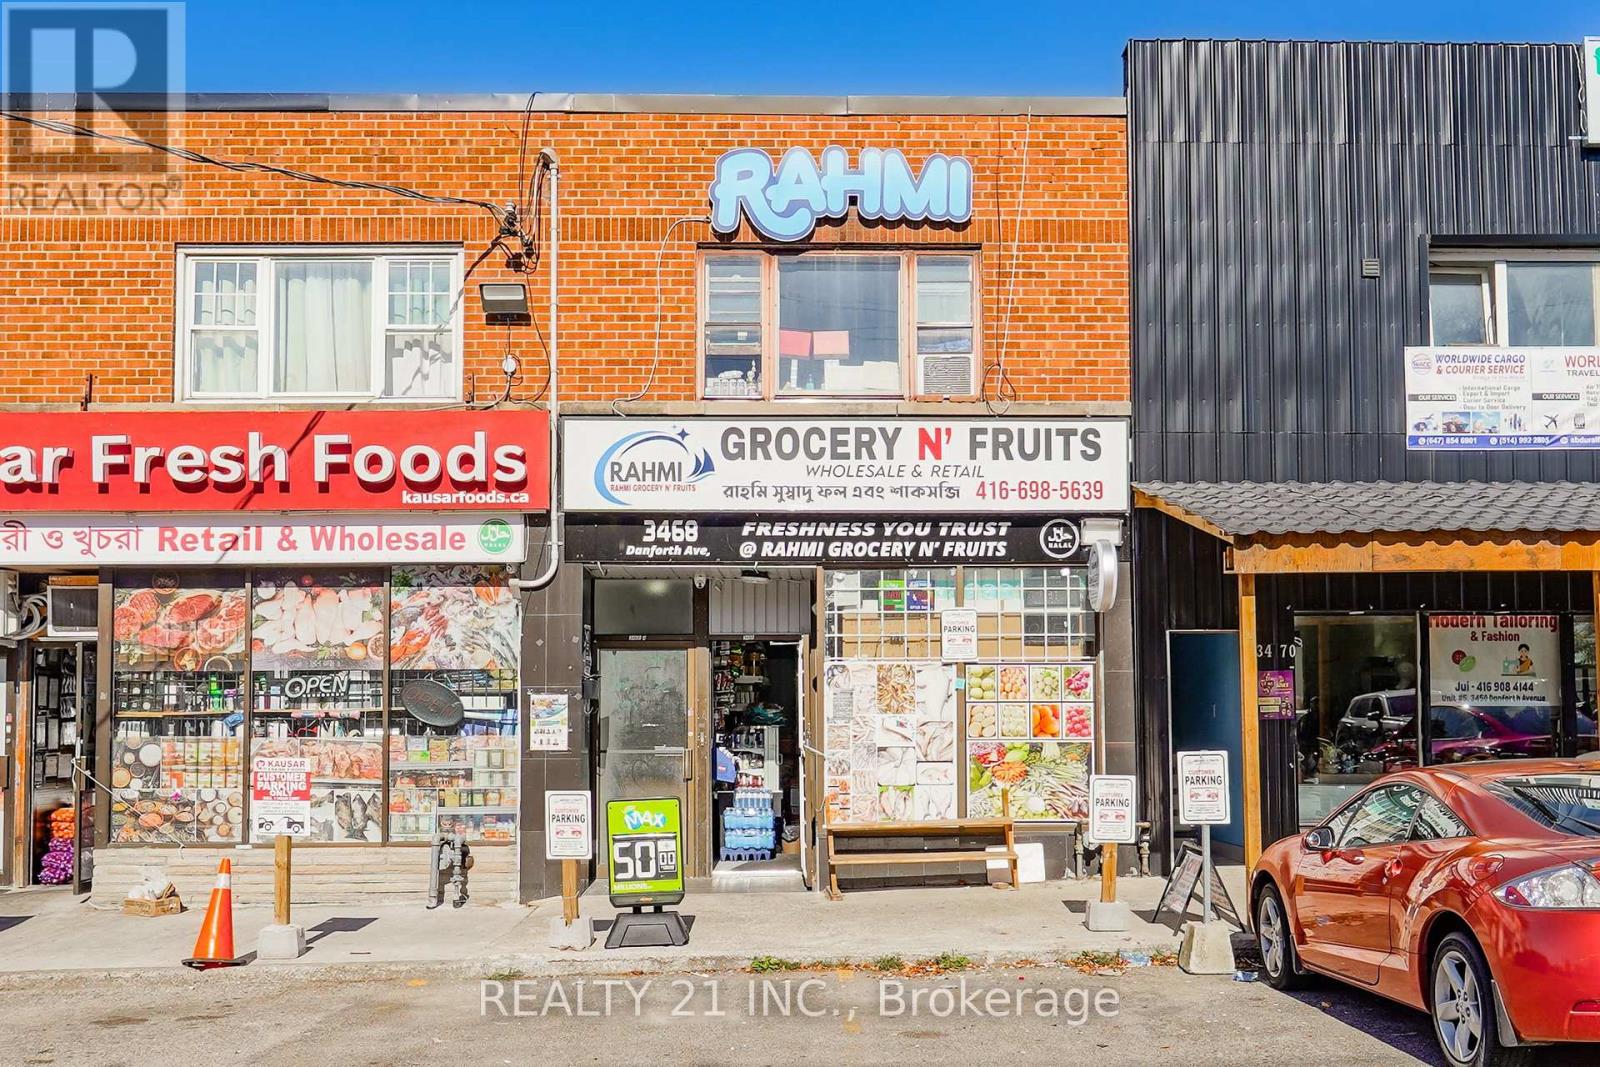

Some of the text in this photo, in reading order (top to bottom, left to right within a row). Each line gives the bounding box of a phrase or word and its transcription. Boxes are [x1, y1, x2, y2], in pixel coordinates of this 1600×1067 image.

[709, 145, 972, 241] RAHMI
[1435, 353, 1526, 364] WORLDWIDE CARGO
[1436, 365, 1525, 375] & COURIER SERVICE
[720, 426, 1102, 461] GROCERY N' FRUITS
[91, 431, 288, 484] Fresh
[313, 431, 528, 484] Foods
[610, 461, 682, 483] RAHMI
[805, 464, 985, 478] WHOLESALE & RETAIL
[610, 483, 632, 492] RAHMI
[633, 483, 663, 492] GROCERY
[673, 483, 697, 492] FRUITS
[817, 485, 847, 498] ফল
[852, 486, 884, 499] এবং
[976, 480, 1104, 500] 416-698-5639
[401, 489, 530, 505] kausarfoods.ca
[642, 519, 699, 542] 3468
[741, 521, 1011, 537] FRESHNESS YOU TRUST
[42, 530, 63, 549] ও
[158, 526, 466, 552] Retail & Wholesale
[626, 544, 684, 558] Danforth
[739, 542, 757, 557] @
[761, 541, 825, 557] RAHMI
[828, 541, 916, 557] GROCERY
[943, 541, 1008, 557] FRUITS
[943, 625, 976, 633] PARKING
[1470, 631, 1520, 642] & Fashion
[284, 672, 350, 698] OPEN
[1455, 681, 1470, 692] Jui
[1476, 682, 1492, 692] 416
[1494, 682, 1513, 692] 908
[1513, 682, 1534, 692] 4144
[1522, 694, 1546, 702] Avenue
[257, 772, 307, 782] CUSTOMER
[1185, 776, 1223, 786] PARKING
[257, 781, 307, 791] PARKING
[1095, 798, 1130, 808] PARKING
[551, 814, 586, 824] PARKING
[613, 841, 656, 879] 50
